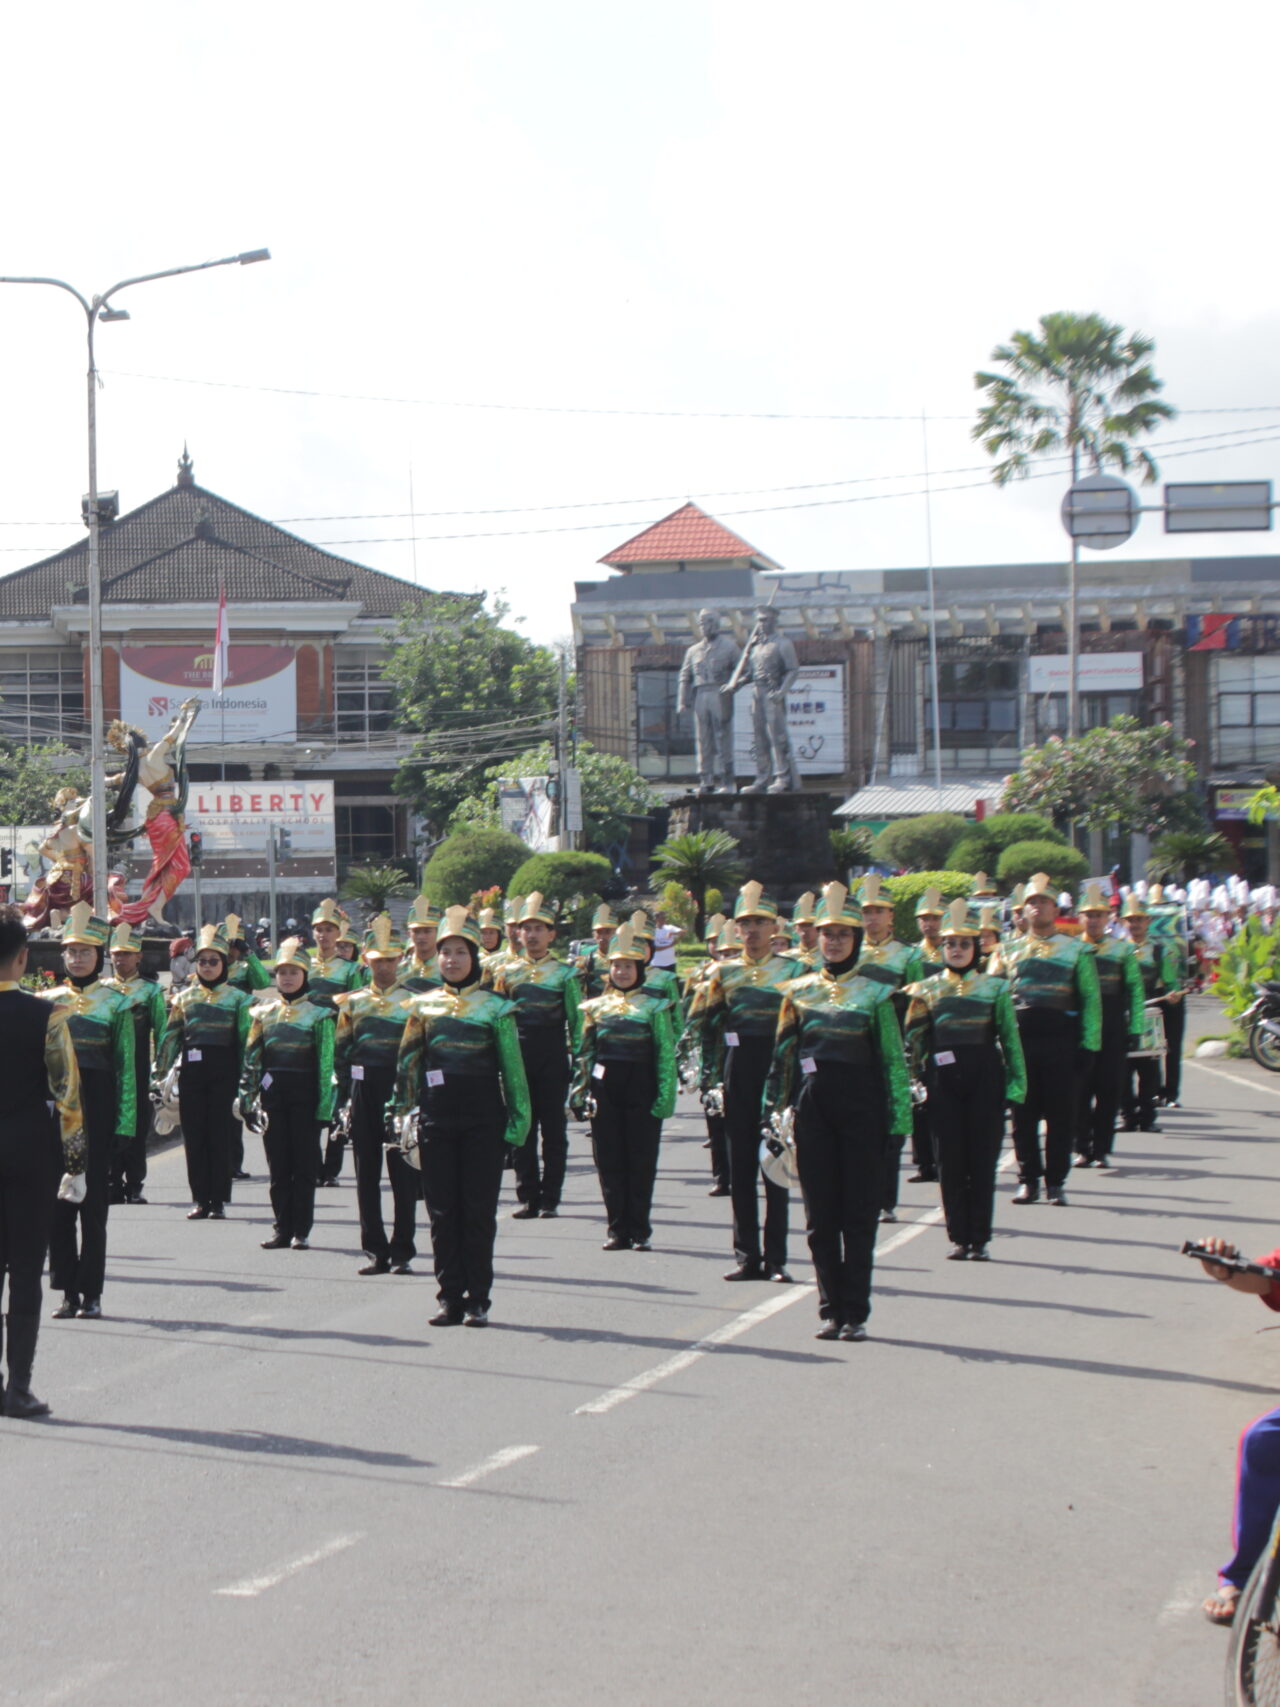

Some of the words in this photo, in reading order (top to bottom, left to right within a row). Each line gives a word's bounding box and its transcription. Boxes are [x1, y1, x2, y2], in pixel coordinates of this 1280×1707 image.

[184, 671, 201, 679] THE
[211, 698, 268, 710] Indonesia
[198, 794, 325, 813] LIBERTY
[199, 816, 275, 826] HOSPITALITY
[281, 816, 325, 825] SCHOOL
